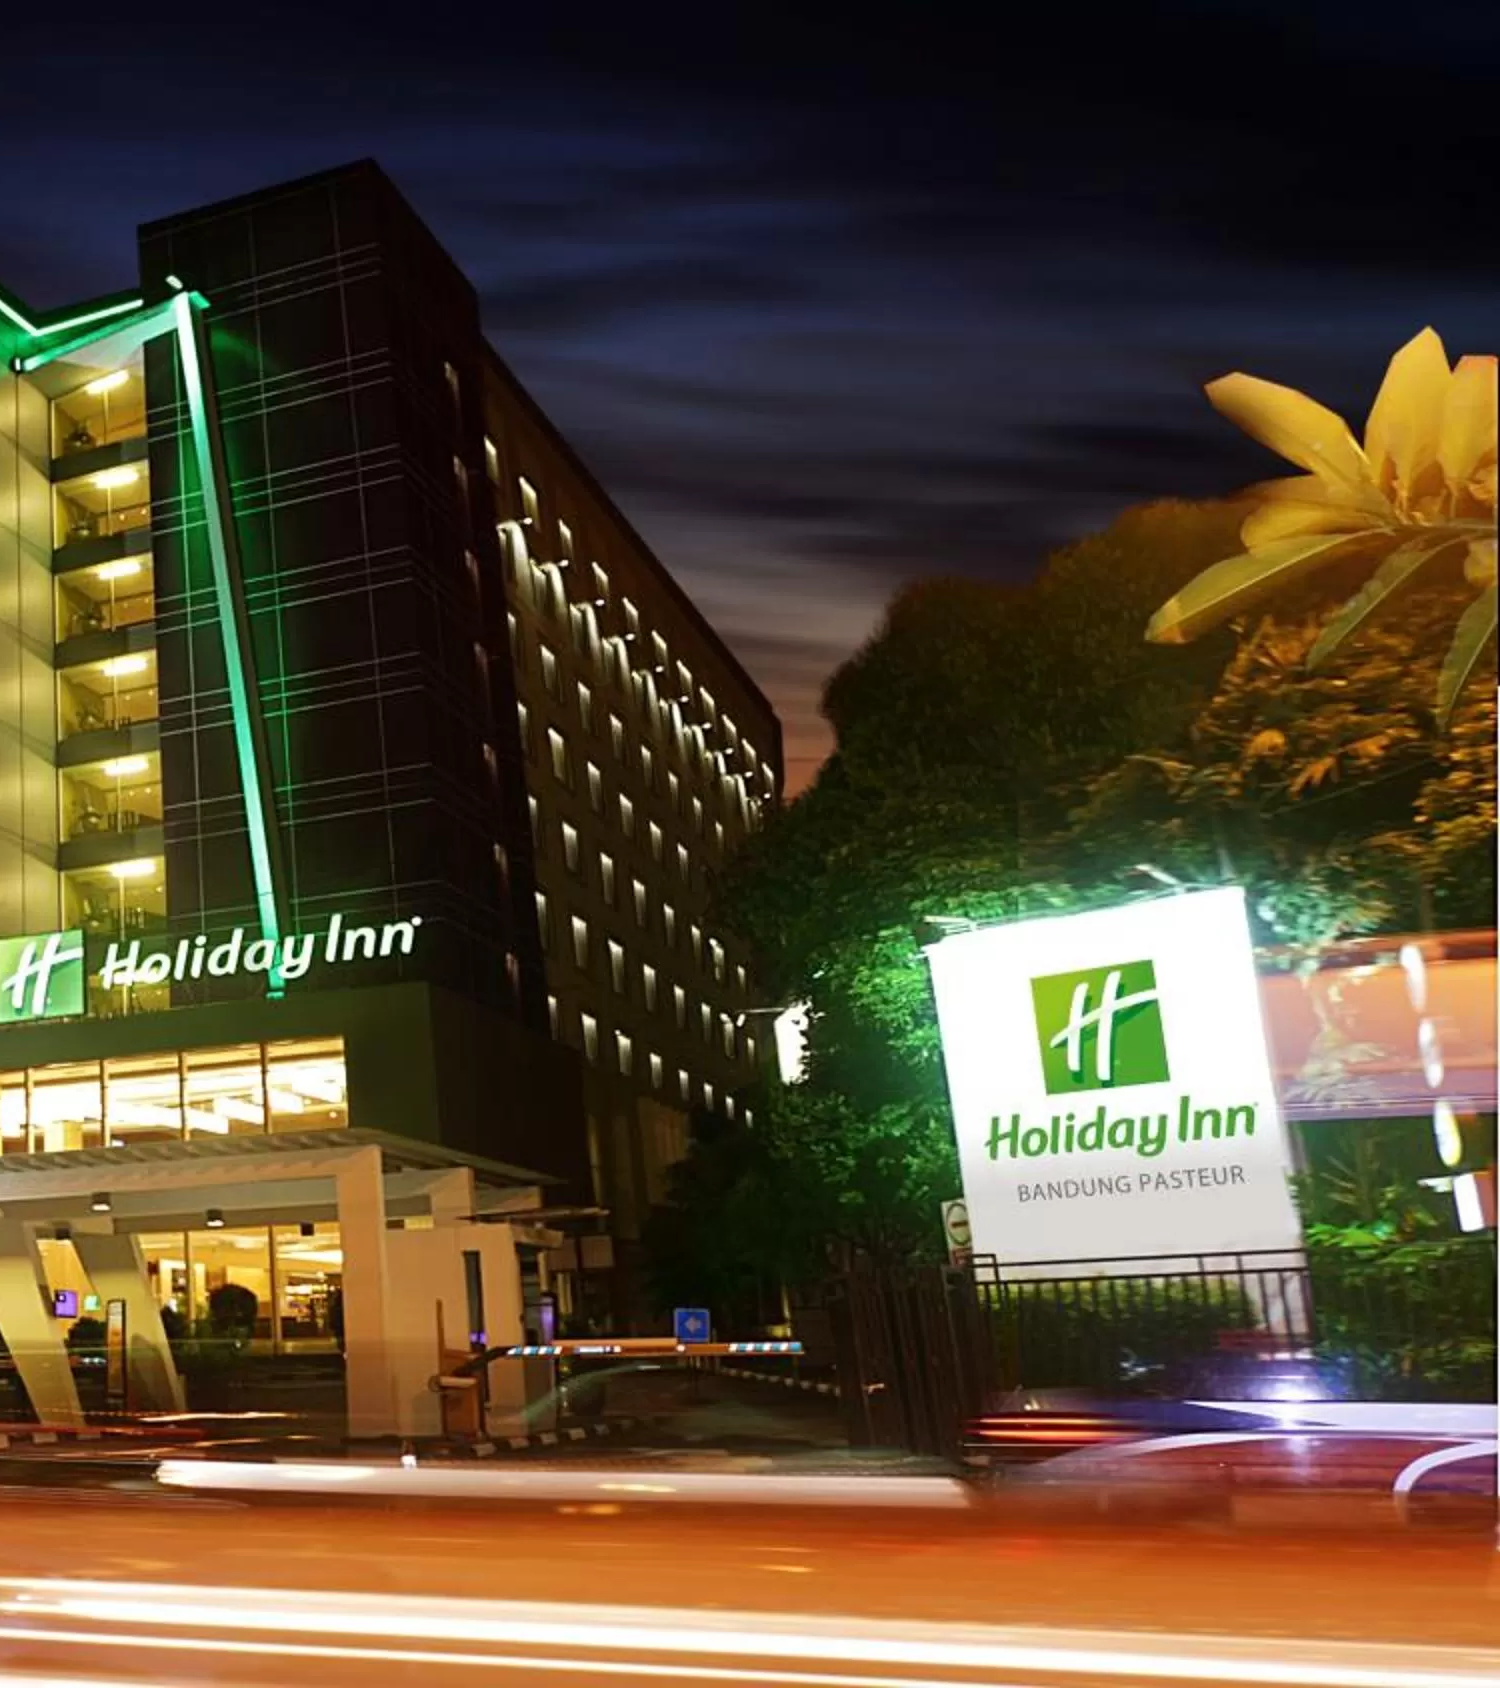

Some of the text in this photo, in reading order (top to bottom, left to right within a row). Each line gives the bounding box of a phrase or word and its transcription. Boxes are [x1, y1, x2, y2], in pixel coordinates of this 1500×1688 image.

[100, 914, 421, 990] Holiday Inn
[984, 1095, 1257, 1160] Holiday Inn
[1017, 1165, 1246, 1203] BANDUNG PASTEUR
